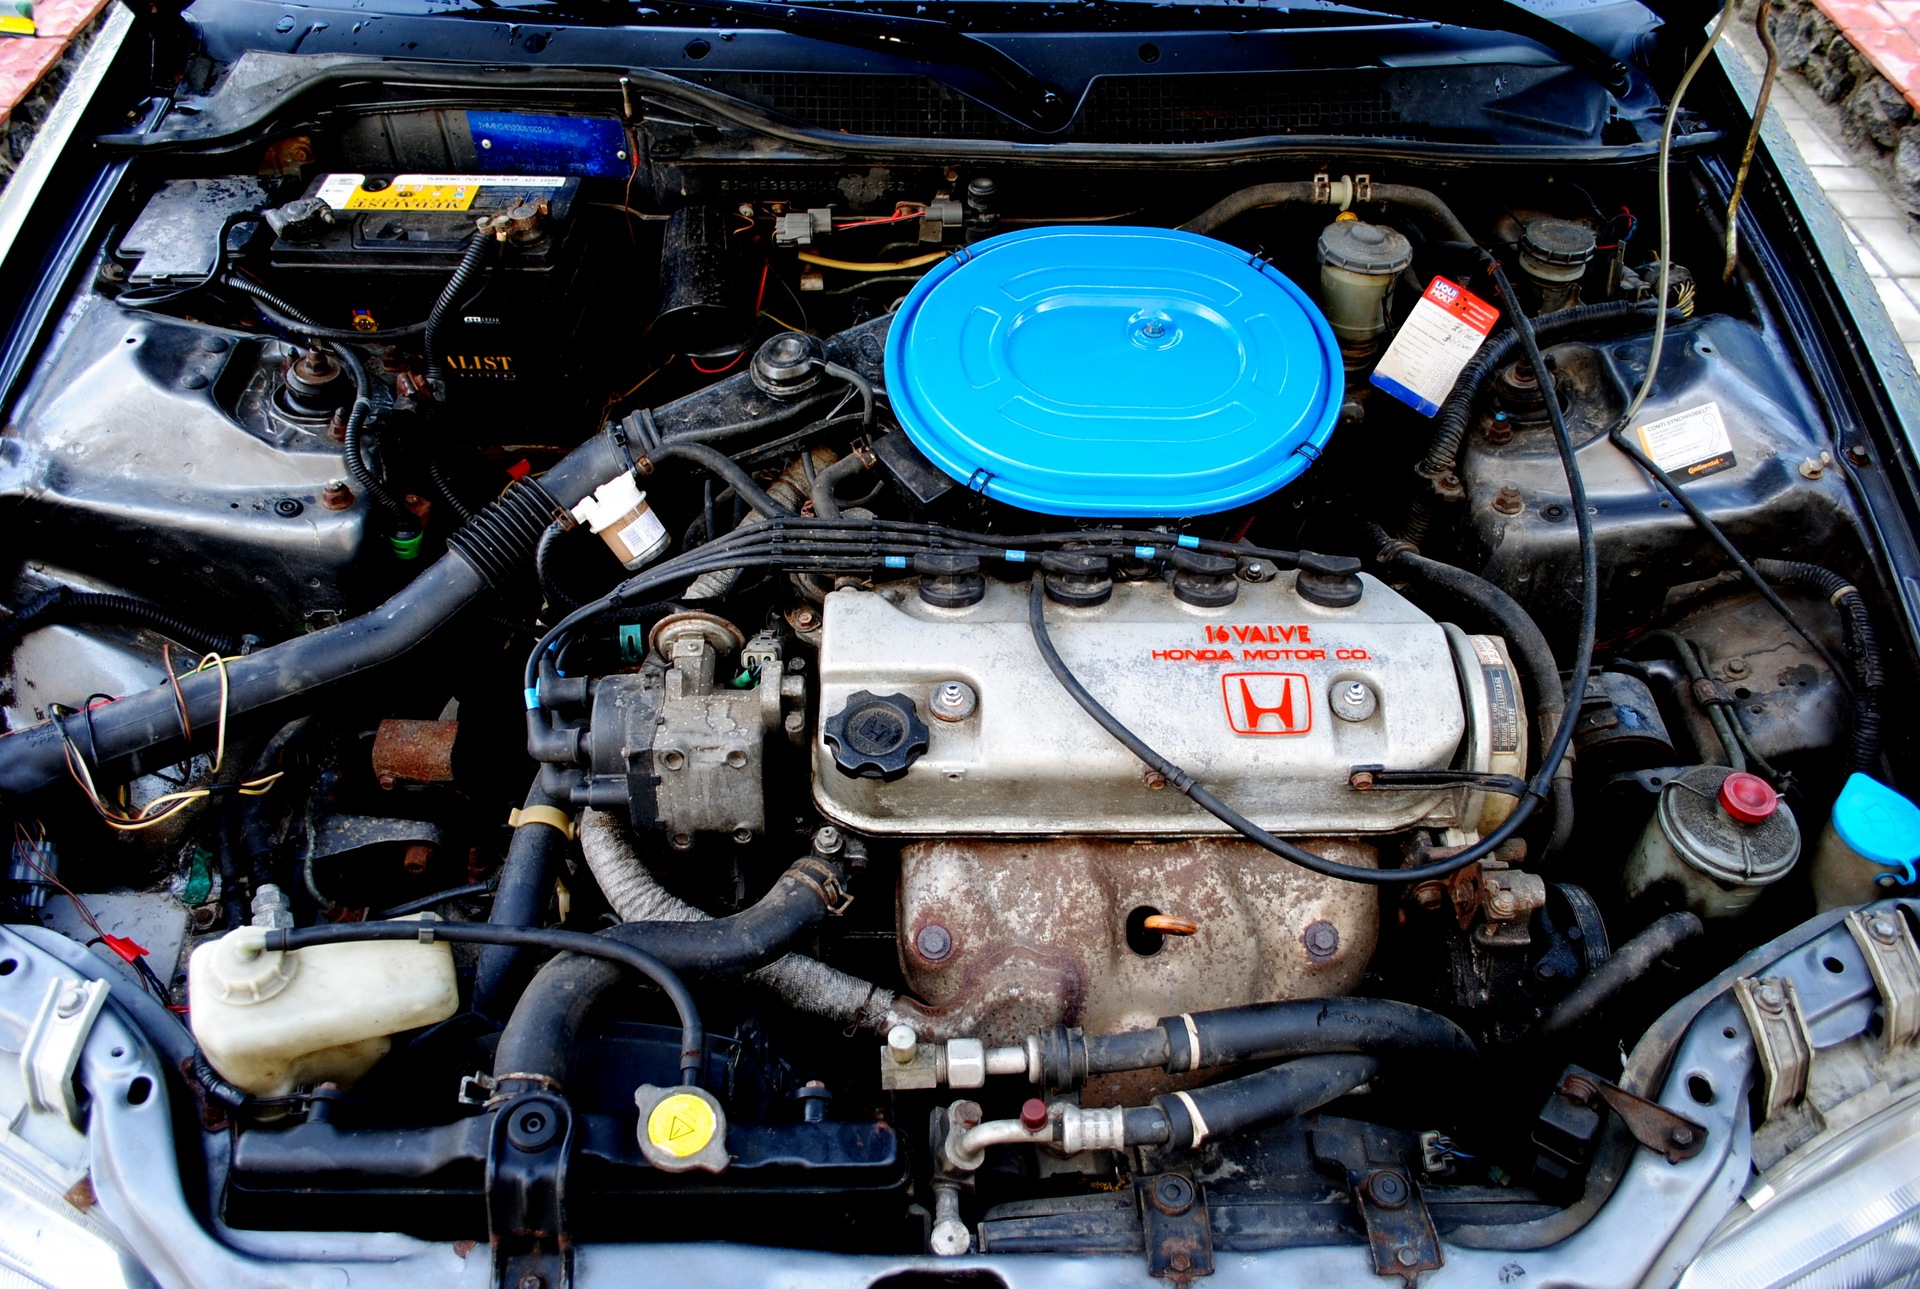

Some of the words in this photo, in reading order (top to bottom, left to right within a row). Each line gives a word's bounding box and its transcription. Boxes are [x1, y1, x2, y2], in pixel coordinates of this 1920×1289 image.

[353, 200, 462, 209] MEDALIST
[1430, 288, 1454, 304] MOLY
[1434, 281, 1459, 298] LIQUI
[1647, 422, 1666, 432] CONTI
[1204, 625, 1230, 644] 16
[1231, 625, 1312, 644] VALVE
[1152, 649, 1234, 661] HONDA
[1243, 649, 1327, 661] MOTOR
[1335, 649, 1373, 661] CO.
